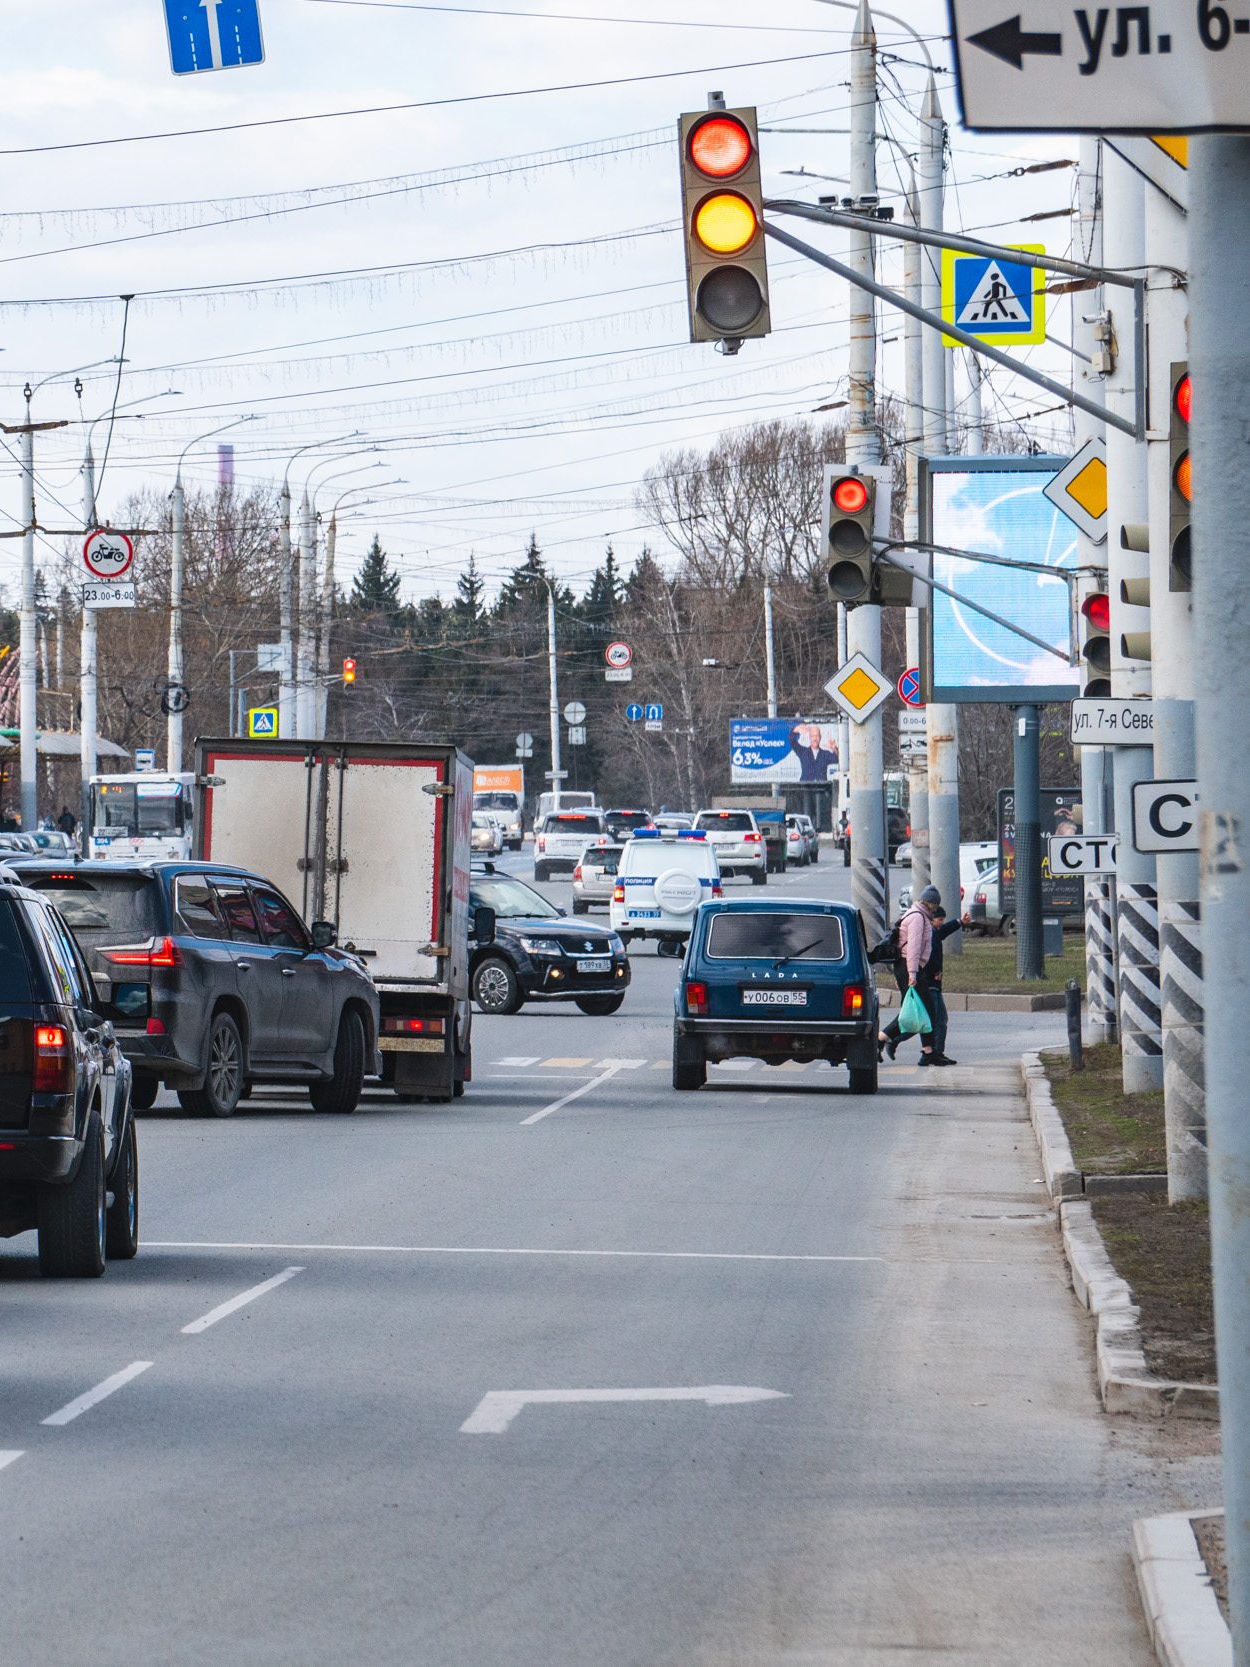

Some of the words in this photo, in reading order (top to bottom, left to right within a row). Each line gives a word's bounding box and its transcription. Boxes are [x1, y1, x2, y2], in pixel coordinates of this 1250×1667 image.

[1074, 7, 1172, 76] ул.
[84, 590, 135, 601] 23.00-6.00
[1074, 711, 1092, 733] ул.
[1097, 708, 1117, 729] 7-я
[732, 748, 763, 766] 6,3%
[1149, 793, 1200, 839] С
[1060, 840, 1117, 869] СТ
[792, 992, 804, 1001] 55
